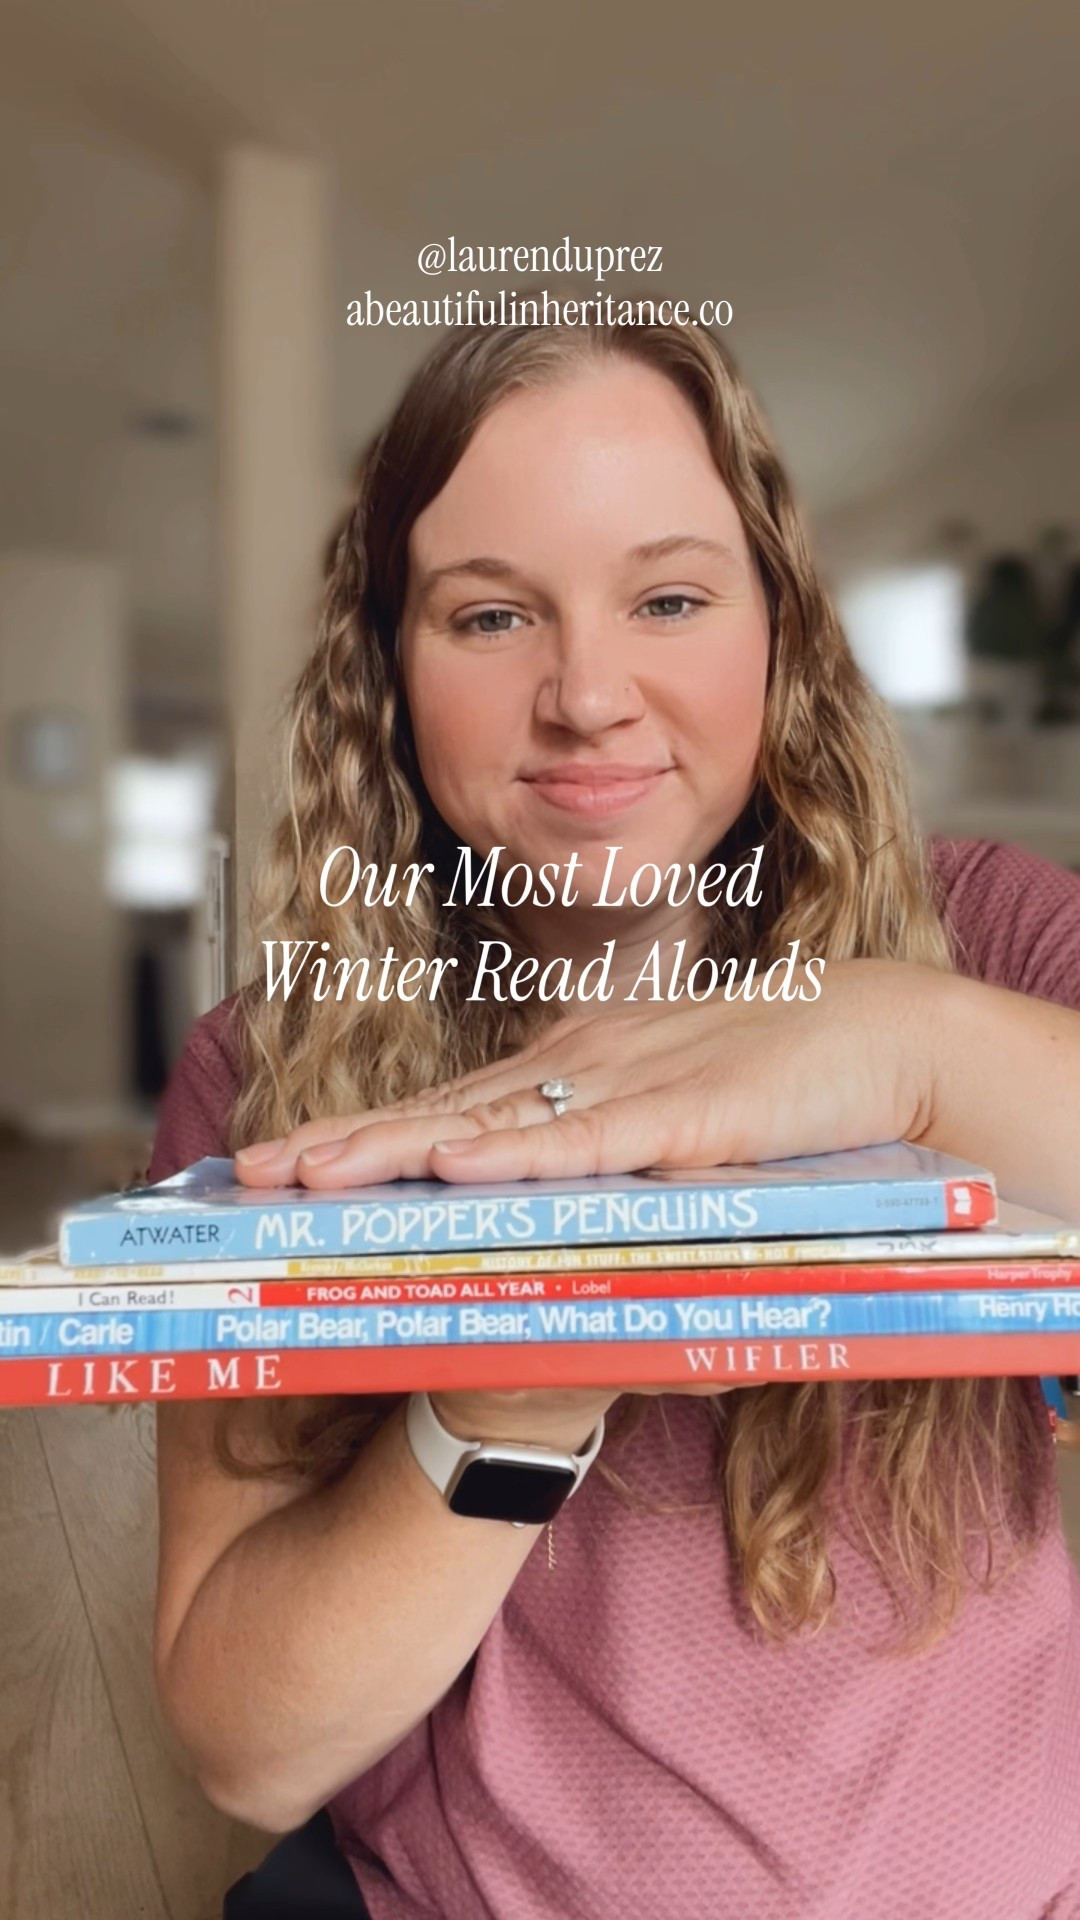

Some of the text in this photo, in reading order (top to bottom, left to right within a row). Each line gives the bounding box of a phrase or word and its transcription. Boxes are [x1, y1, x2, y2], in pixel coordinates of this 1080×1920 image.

[120, 1224, 220, 1247] ATWATER
[255, 1211, 325, 1250] MR.
[341, 1199, 536, 1246] POPPER'S
[78, 1289, 175, 1307] I Can Read!
[227, 1286, 254, 1304] 2
[306, 1286, 357, 1302] FROG
[360, 1284, 402, 1300] AND
[404, 1283, 457, 1299] TOAD
[459, 1282, 495, 1298] ALL
[496, 1281, 546, 1297] YEAR
[571, 1280, 612, 1296] Lobel
[58, 1317, 134, 1347] Carle
[216, 1313, 291, 1343] Polar
[298, 1311, 369, 1343] Bear,
[377, 1307, 452, 1338] Polar
[459, 1307, 532, 1338] Bear,
[538, 1304, 616, 1335] What
[624, 1303, 668, 1333] Do
[674, 1303, 733, 1331] You
[741, 1299, 832, 1329] Hear?
[979, 1296, 1048, 1324] Henry
[47, 1343, 850, 1397] LIKE ME WIFLER
